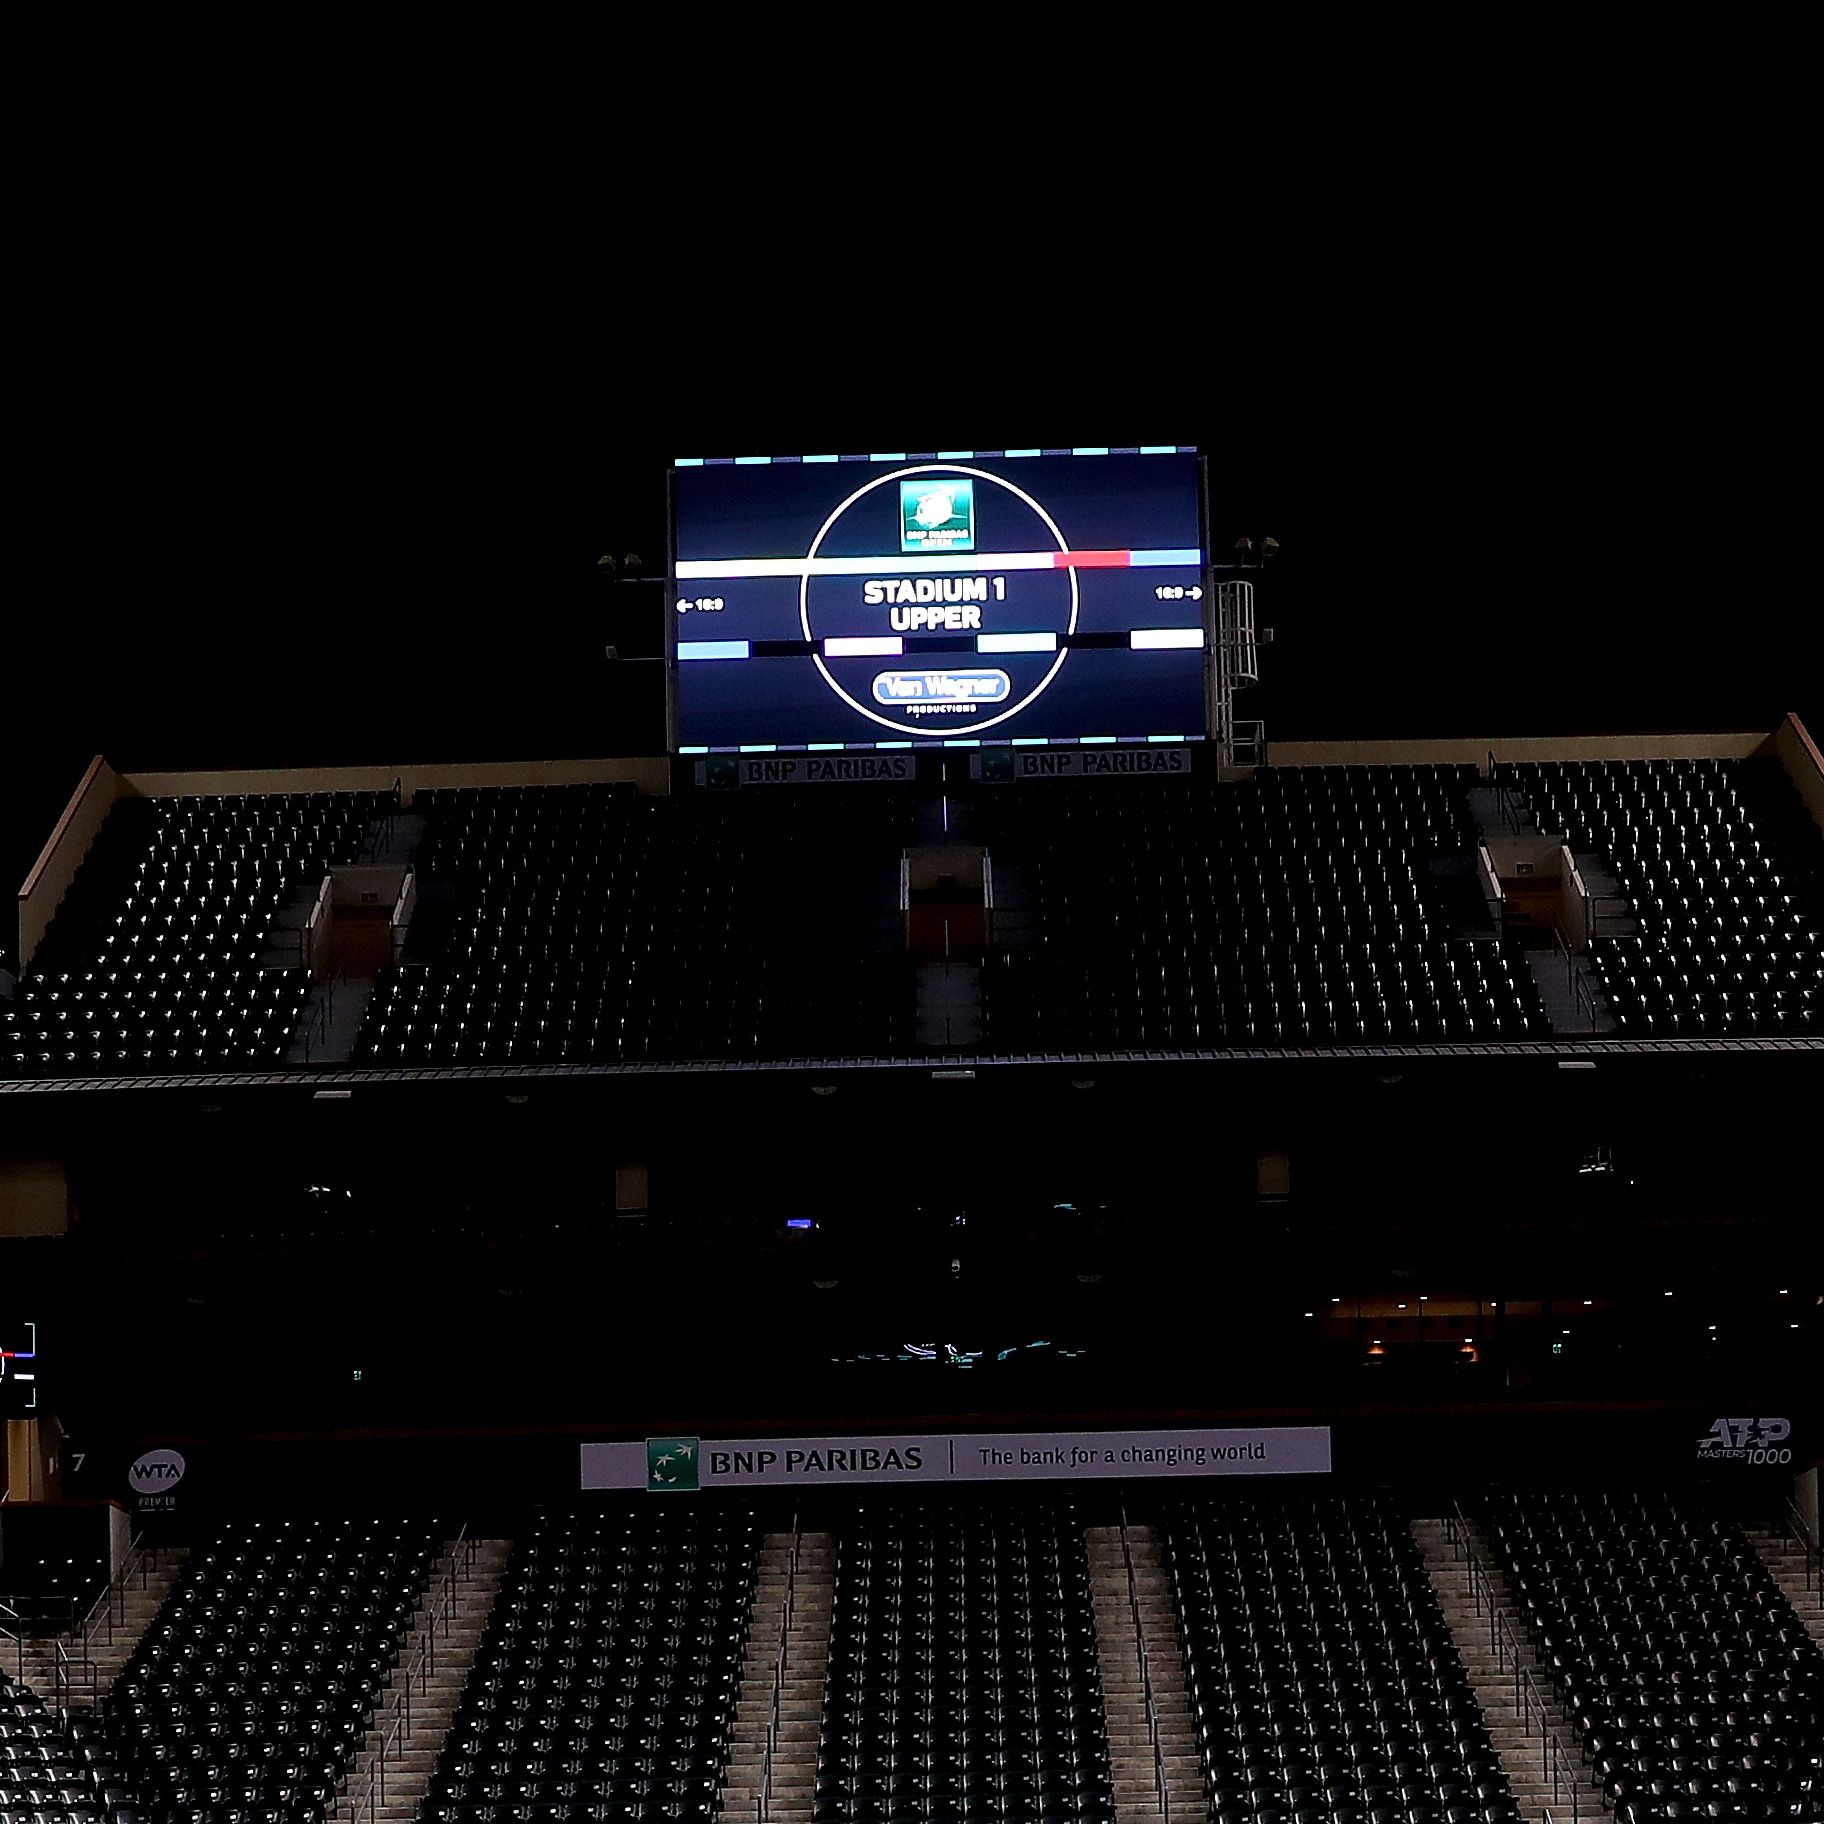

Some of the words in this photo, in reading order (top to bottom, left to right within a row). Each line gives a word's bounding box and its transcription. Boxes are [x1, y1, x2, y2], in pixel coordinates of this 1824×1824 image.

[864, 577, 987, 603] STADIUM
[992, 576, 1006, 600] 1
[890, 605, 982, 630] UPPER
[884, 676, 923, 697] Van
[924, 676, 999, 699] Wagner
[907, 705, 977, 716] PRODUCTIONS
[747, 760, 796, 782] BNP
[806, 758, 907, 780] PARIBAS
[1021, 755, 1072, 777] BNP
[1081, 751, 1183, 774] PARIBAS
[1696, 1418, 1791, 1447] ATP
[72, 1453, 86, 1472] 7
[710, 1448, 776, 1475] BNP
[785, 1446, 923, 1473] PARIBAS
[979, 1447, 1014, 1467] The
[1019, 1444, 1065, 1466] bank
[1068, 1443, 1097, 1468] for
[1103, 1448, 1115, 1463] a
[1119, 1442, 1207, 1468] changing
[1210, 1440, 1266, 1462] world
[1697, 1449, 1746, 1458] MASTERS
[1746, 1449, 1792, 1465] 1000
[133, 1463, 181, 1479] WTA
